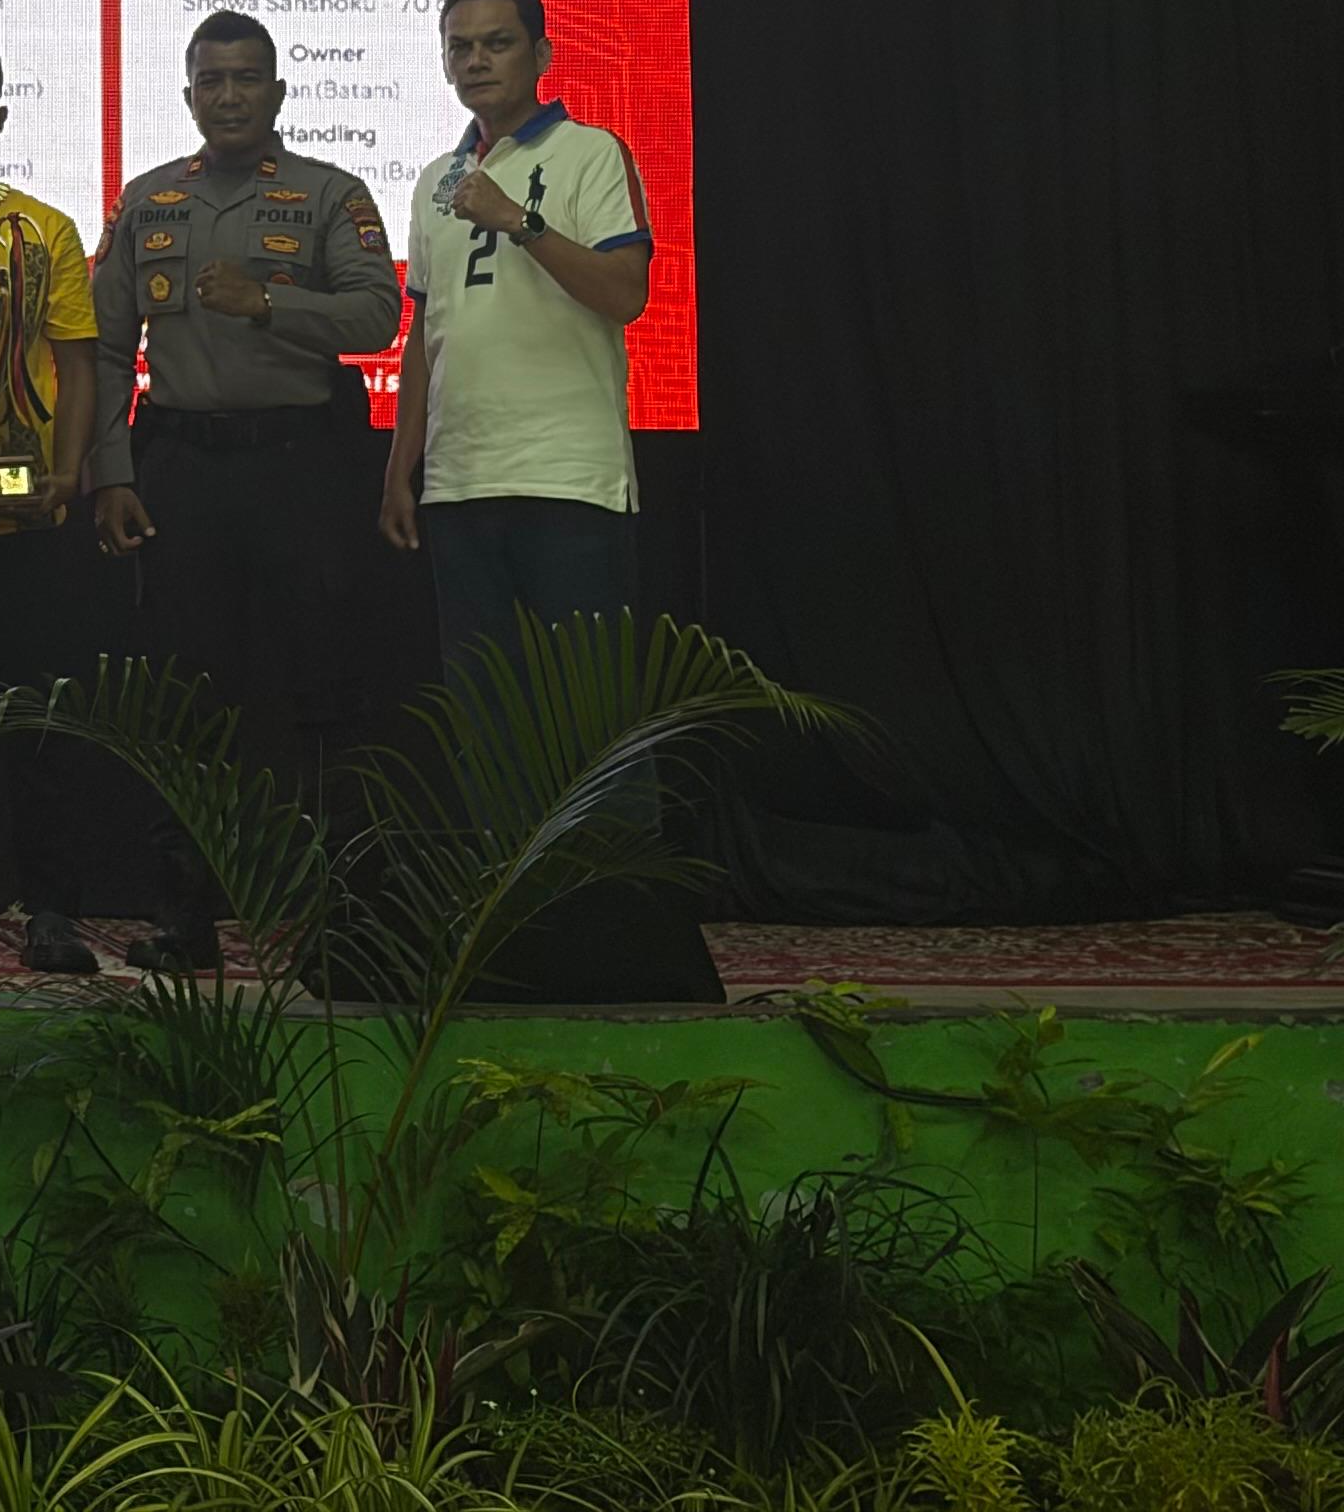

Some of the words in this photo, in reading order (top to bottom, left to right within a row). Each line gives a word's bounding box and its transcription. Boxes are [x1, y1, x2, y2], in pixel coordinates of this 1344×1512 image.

[290, 44, 365, 62] Owner
[316, 79, 400, 100] (Batam)
[280, 125, 376, 148] Handling
[139, 209, 192, 224] IDHAM
[255, 209, 312, 225] POLRI
[465, 224, 498, 288] 2
